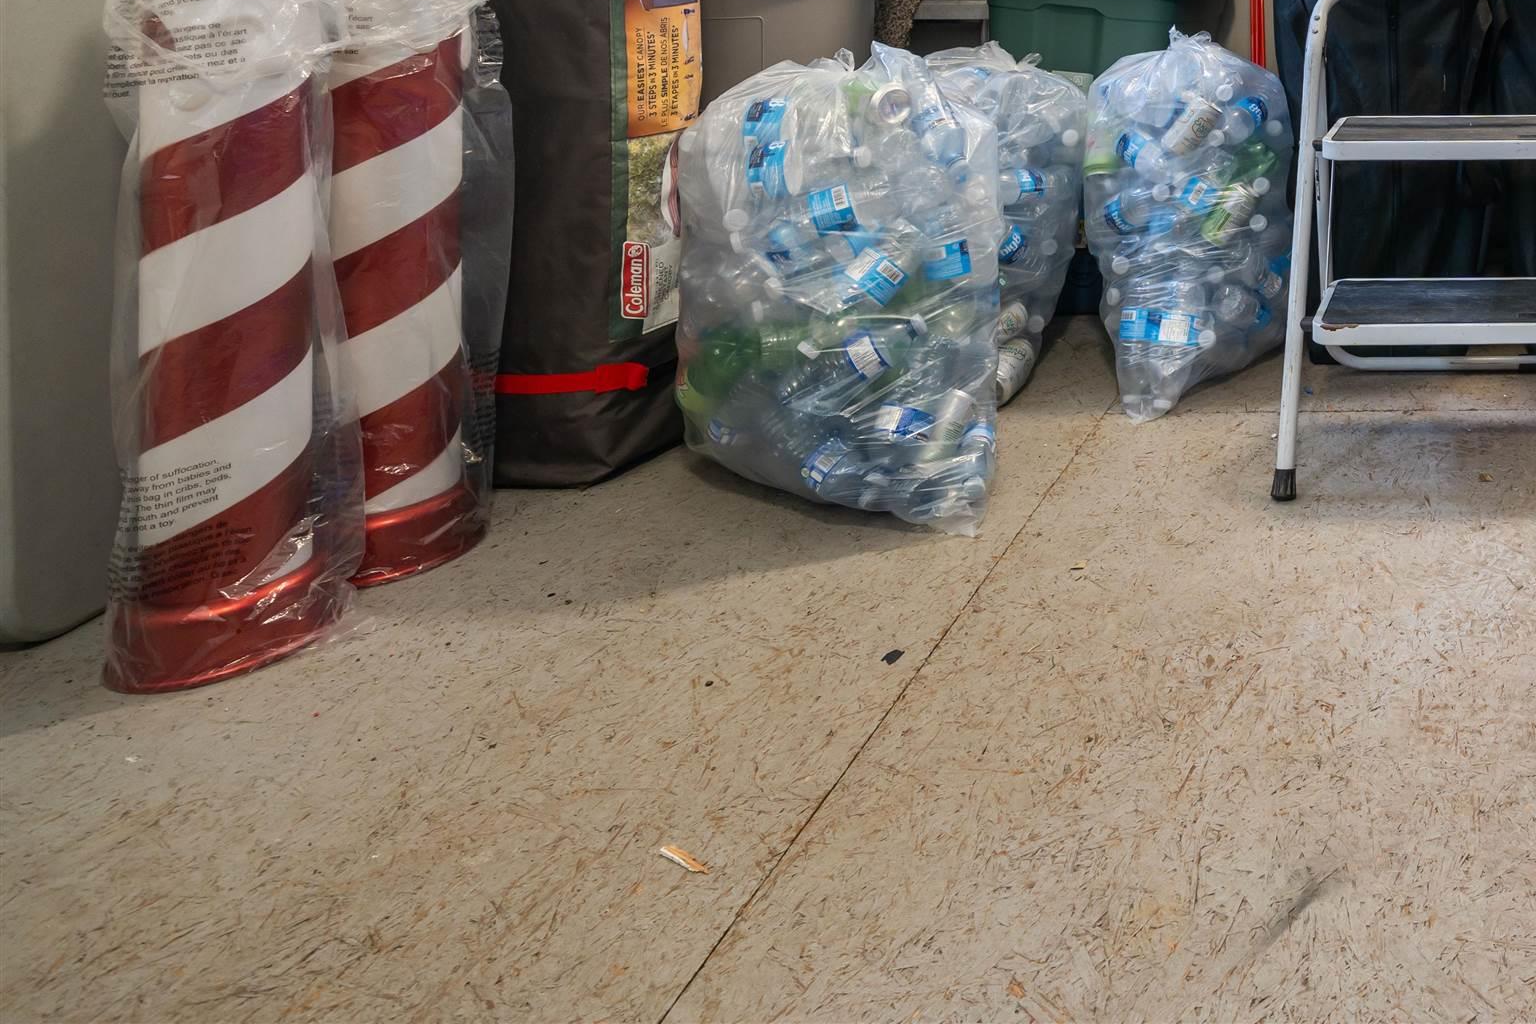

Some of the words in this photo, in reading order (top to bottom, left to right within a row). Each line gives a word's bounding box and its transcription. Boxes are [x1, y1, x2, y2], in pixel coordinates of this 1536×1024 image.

[660, 17, 668, 38] ABRIS
[635, 27, 644, 60] CANOPY
[660, 39, 668, 55] NOS
[660, 56, 668, 67] DE
[637, 63, 645, 102] EASIEST
[648, 84, 657, 109] STEPS
[661, 100, 669, 117] PLUS
[637, 103, 646, 121] OUR
[625, 258, 644, 315] Coleman
[152, 481, 175, 491] from
[178, 471, 210, 485] babies
[213, 463, 232, 474] and
[143, 493, 161, 502] bag
[155, 500, 174, 510] thin
[176, 493, 194, 504] film
[196, 486, 217, 497] may
[160, 507, 179, 518] and
[181, 494, 219, 513] prevent
